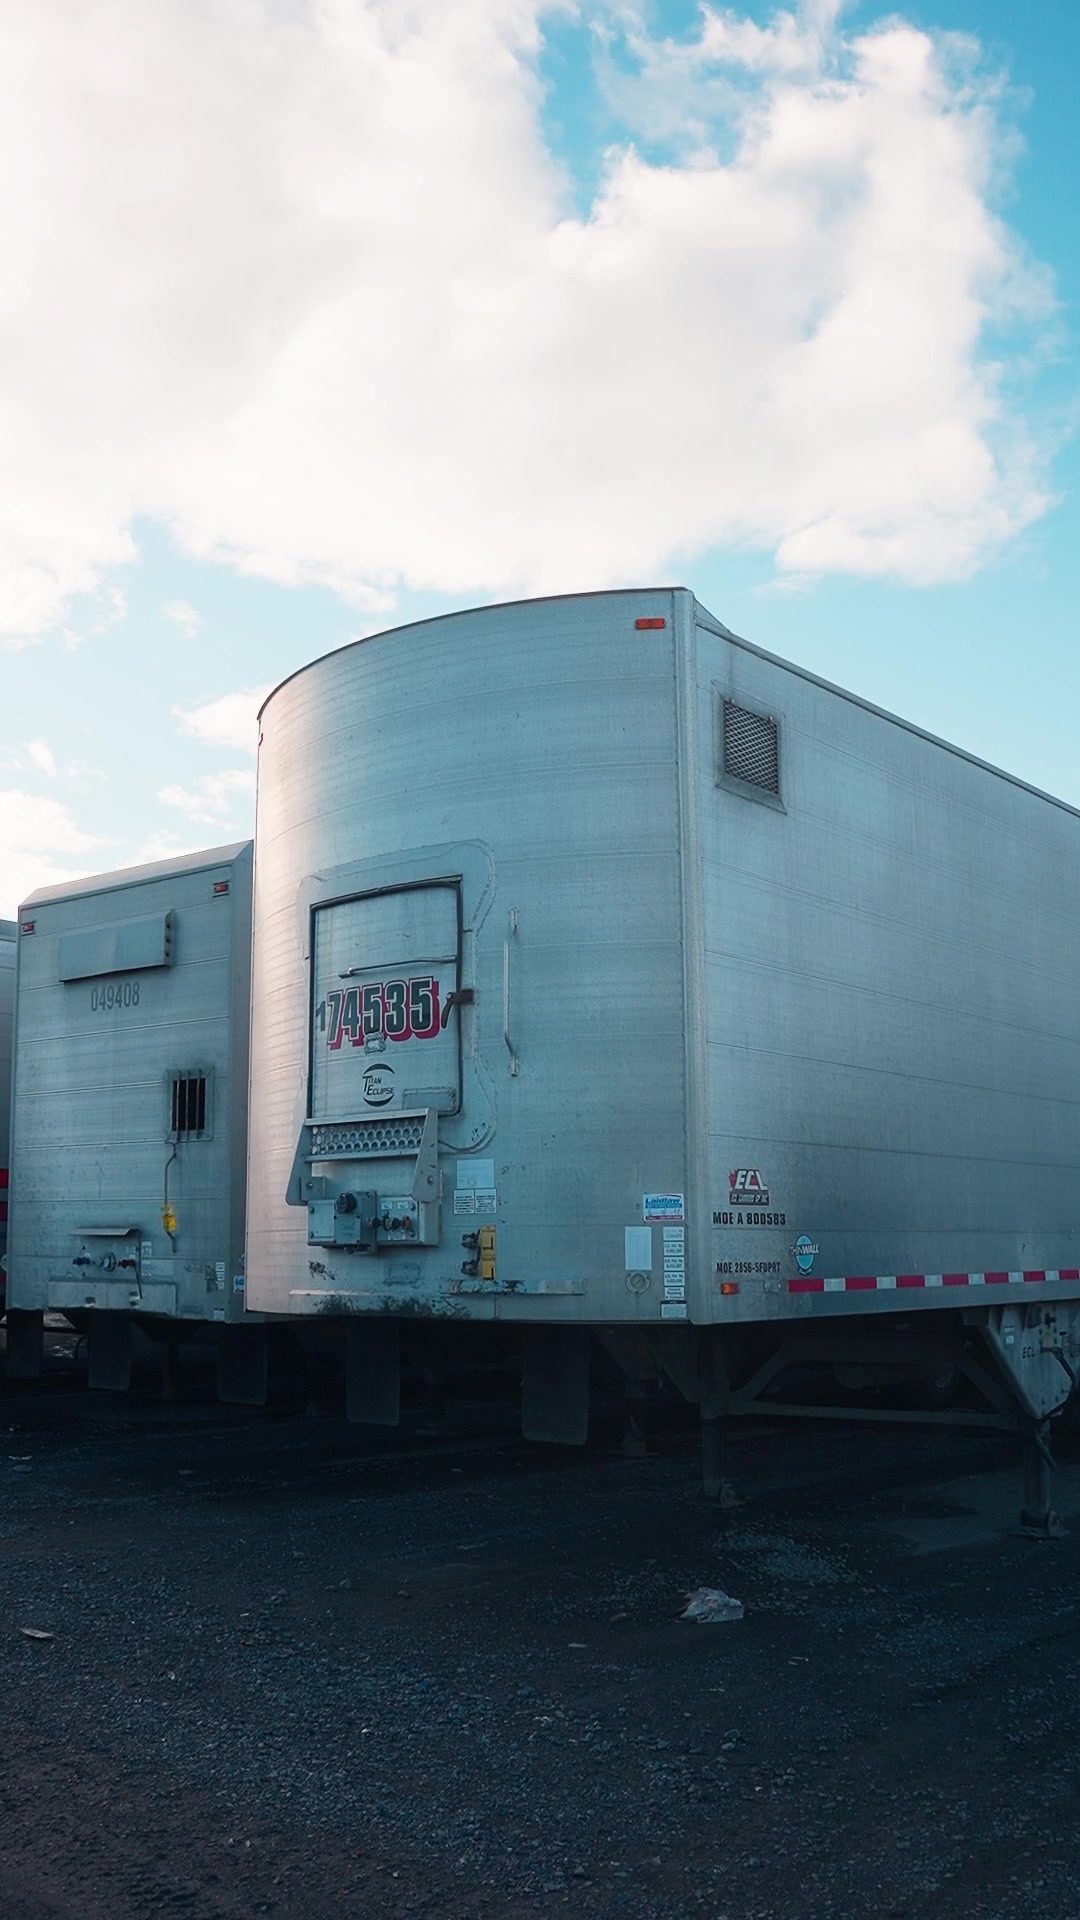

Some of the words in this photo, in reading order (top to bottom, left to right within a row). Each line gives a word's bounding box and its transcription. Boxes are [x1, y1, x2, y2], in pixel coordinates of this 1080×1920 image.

[91, 982, 140, 1012] 049408
[735, 1170, 768, 1190] ECL
[713, 1212, 733, 1225] MOE
[737, 1212, 744, 1225] A
[747, 1213, 786, 1226] 800583
[717, 1262, 732, 1274] MOE
[1022, 1346, 1035, 1359] ECL
